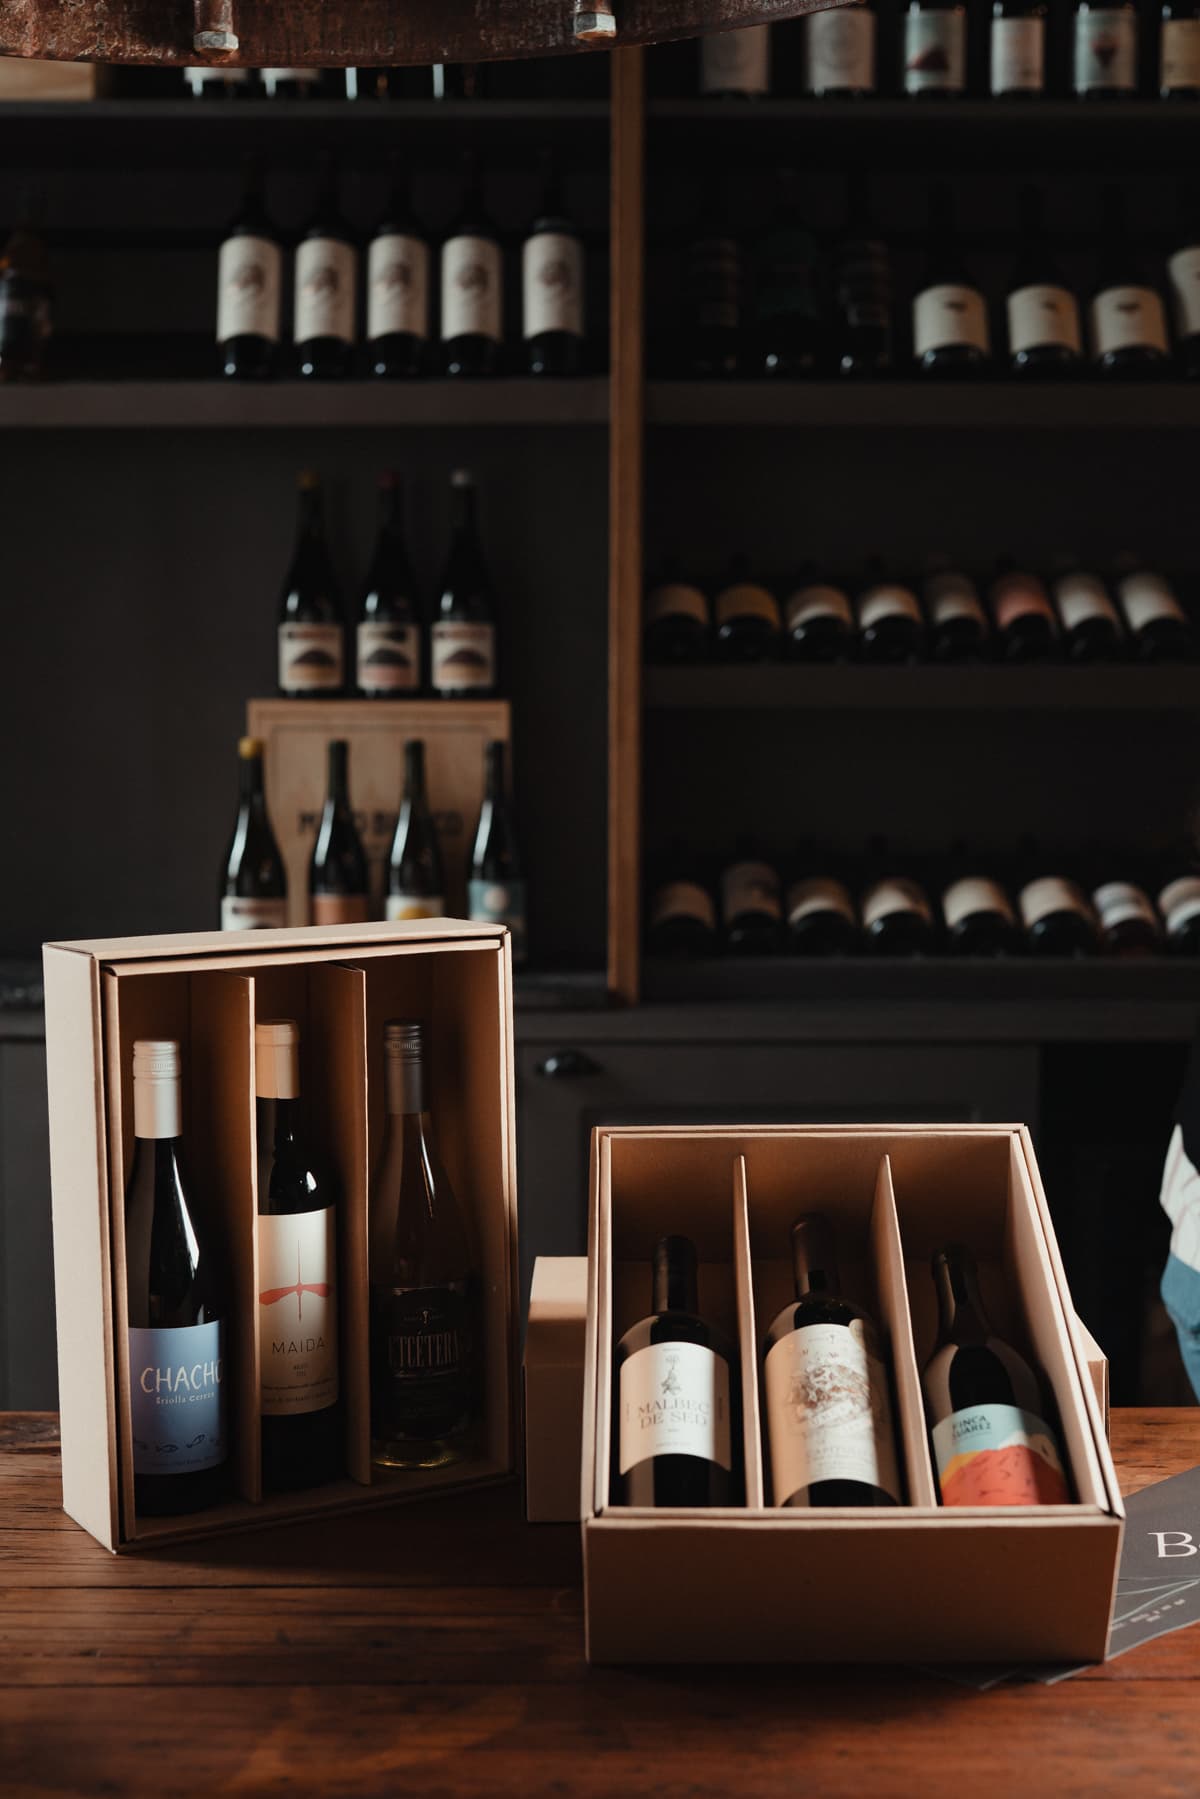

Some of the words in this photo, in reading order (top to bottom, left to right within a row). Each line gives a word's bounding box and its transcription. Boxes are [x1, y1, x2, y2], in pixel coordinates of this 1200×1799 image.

[271, 1336, 326, 1355] MAIDA
[637, 1398, 711, 1418] MALBEC
[639, 1411, 665, 1430] DE
[951, 1415, 987, 1431] FINCA
[1147, 1531, 1200, 1558] B
